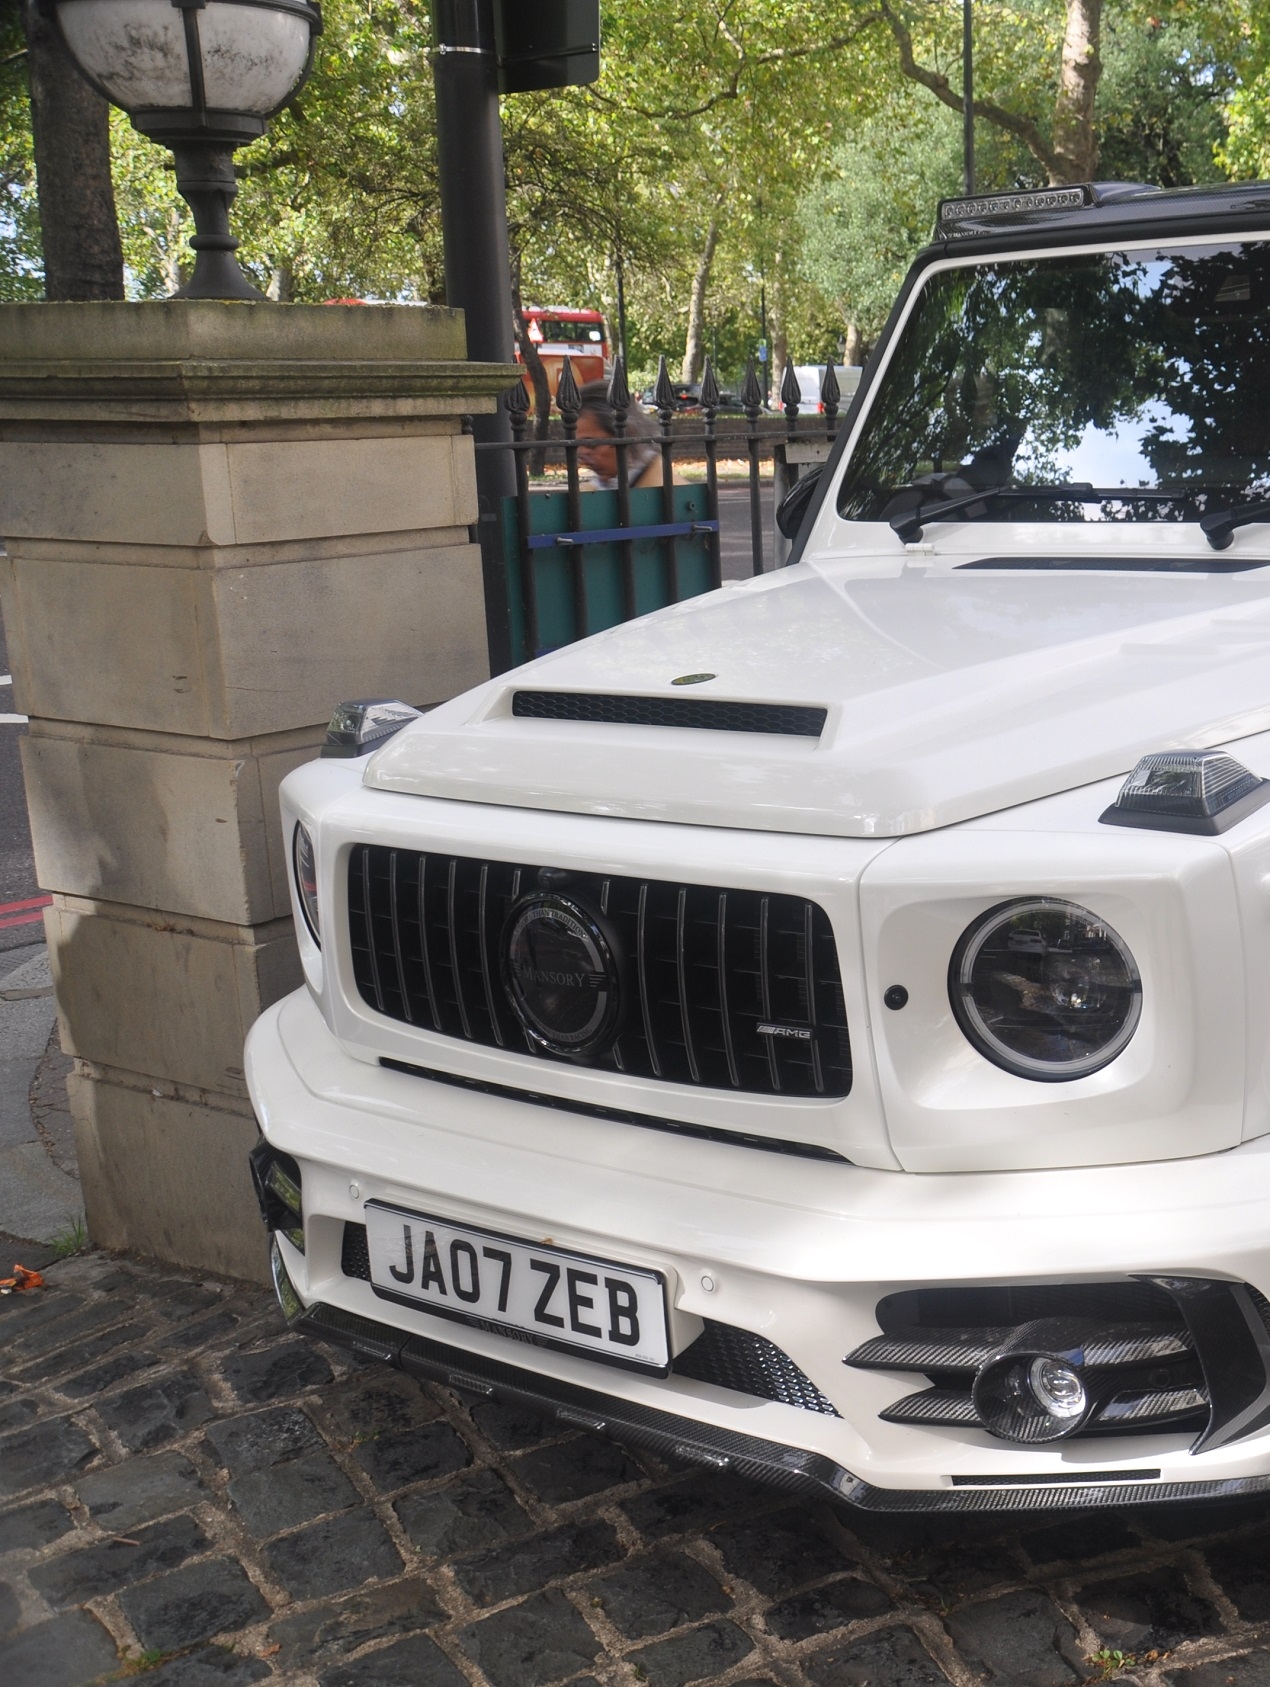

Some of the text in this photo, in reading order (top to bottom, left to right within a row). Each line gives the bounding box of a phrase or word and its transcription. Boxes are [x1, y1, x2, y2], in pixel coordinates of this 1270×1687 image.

[523, 965, 585, 987] MANSORY
[774, 1027, 811, 1039] AMG
[389, 1224, 641, 1347] JA07 ZEB
